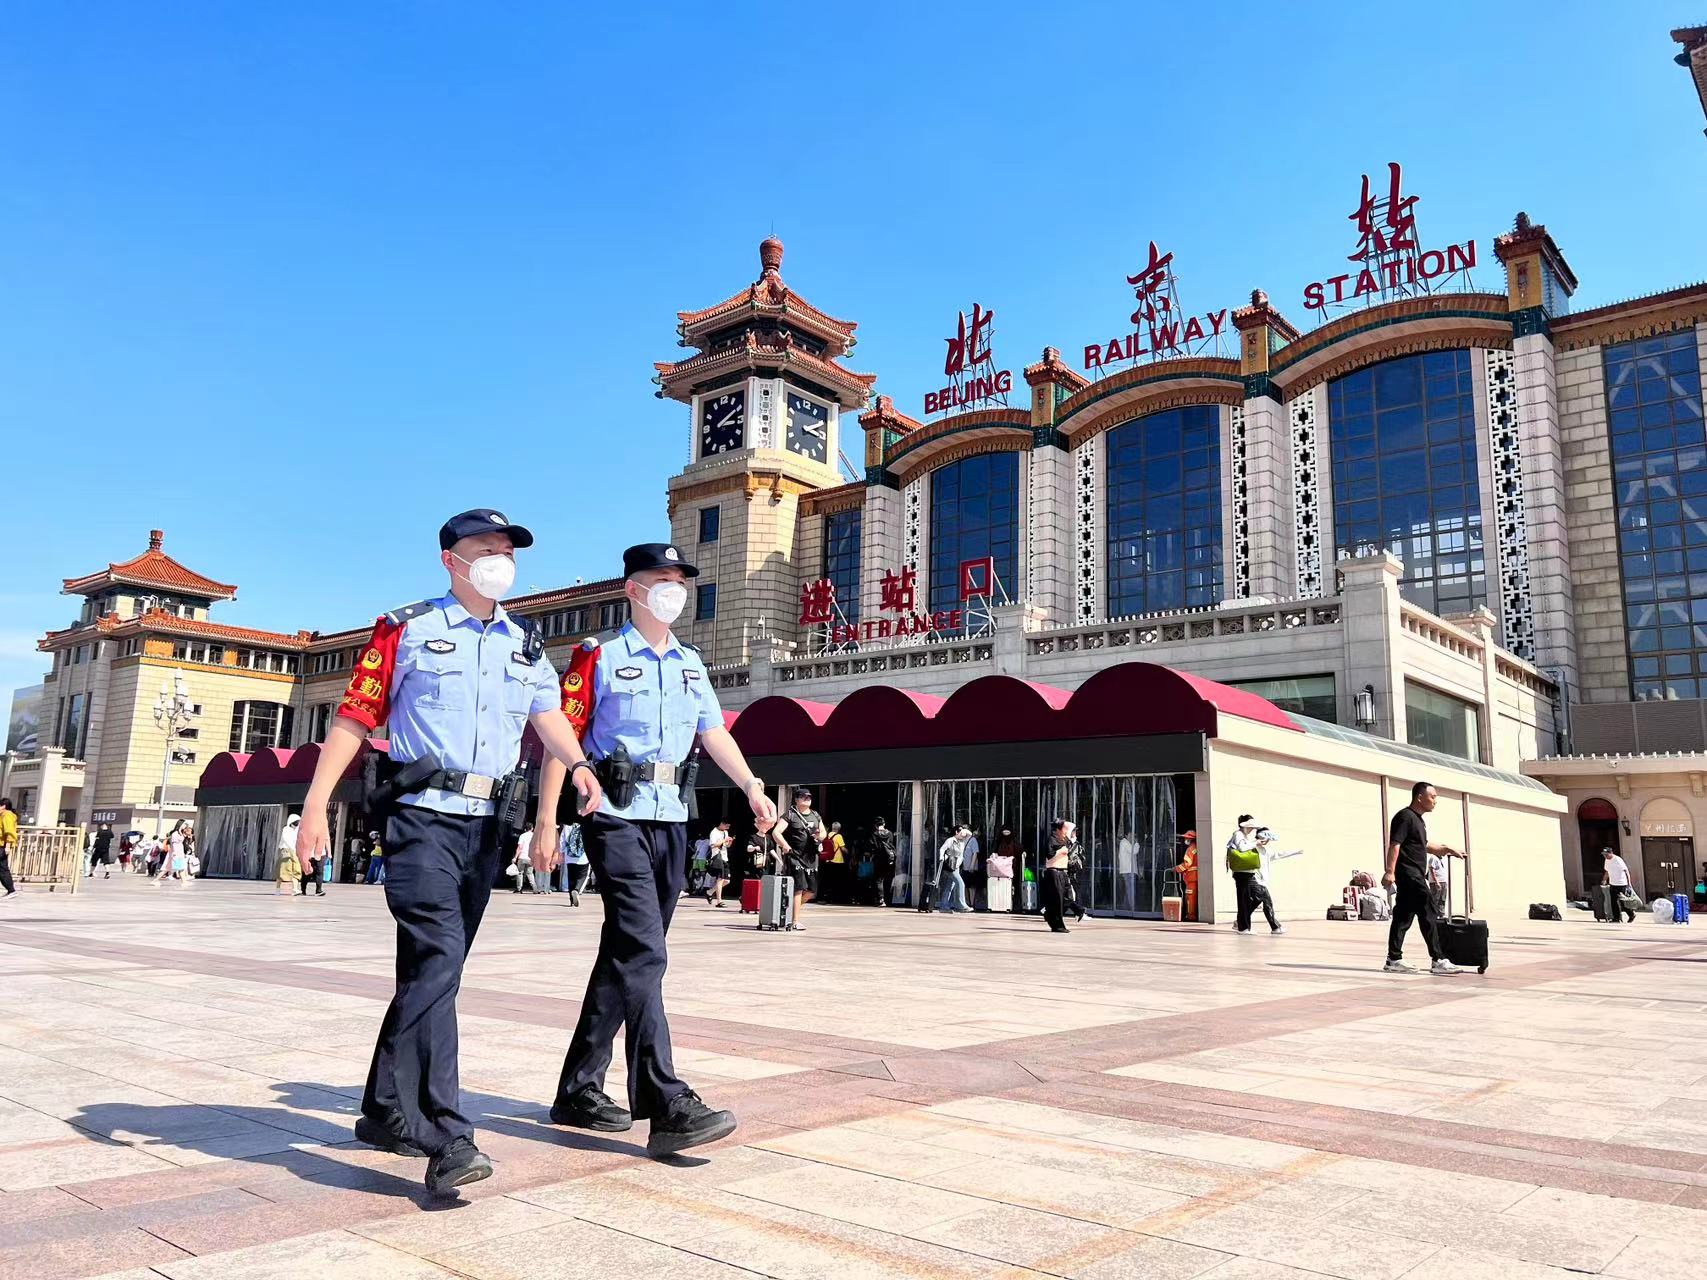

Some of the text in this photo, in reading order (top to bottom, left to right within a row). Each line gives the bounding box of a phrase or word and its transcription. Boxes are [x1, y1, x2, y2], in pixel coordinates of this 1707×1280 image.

[945, 162, 1420, 376] 北 京 站
[923, 239, 1477, 415] BEIJING RAILWAY STATION
[720, 395, 729, 405] 12
[802, 399, 811, 409] 12
[703, 425, 710, 433] 9
[719, 444, 727, 453] 6
[800, 556, 994, 626] 进站口
[831, 609, 963, 644] ENTRANCE
